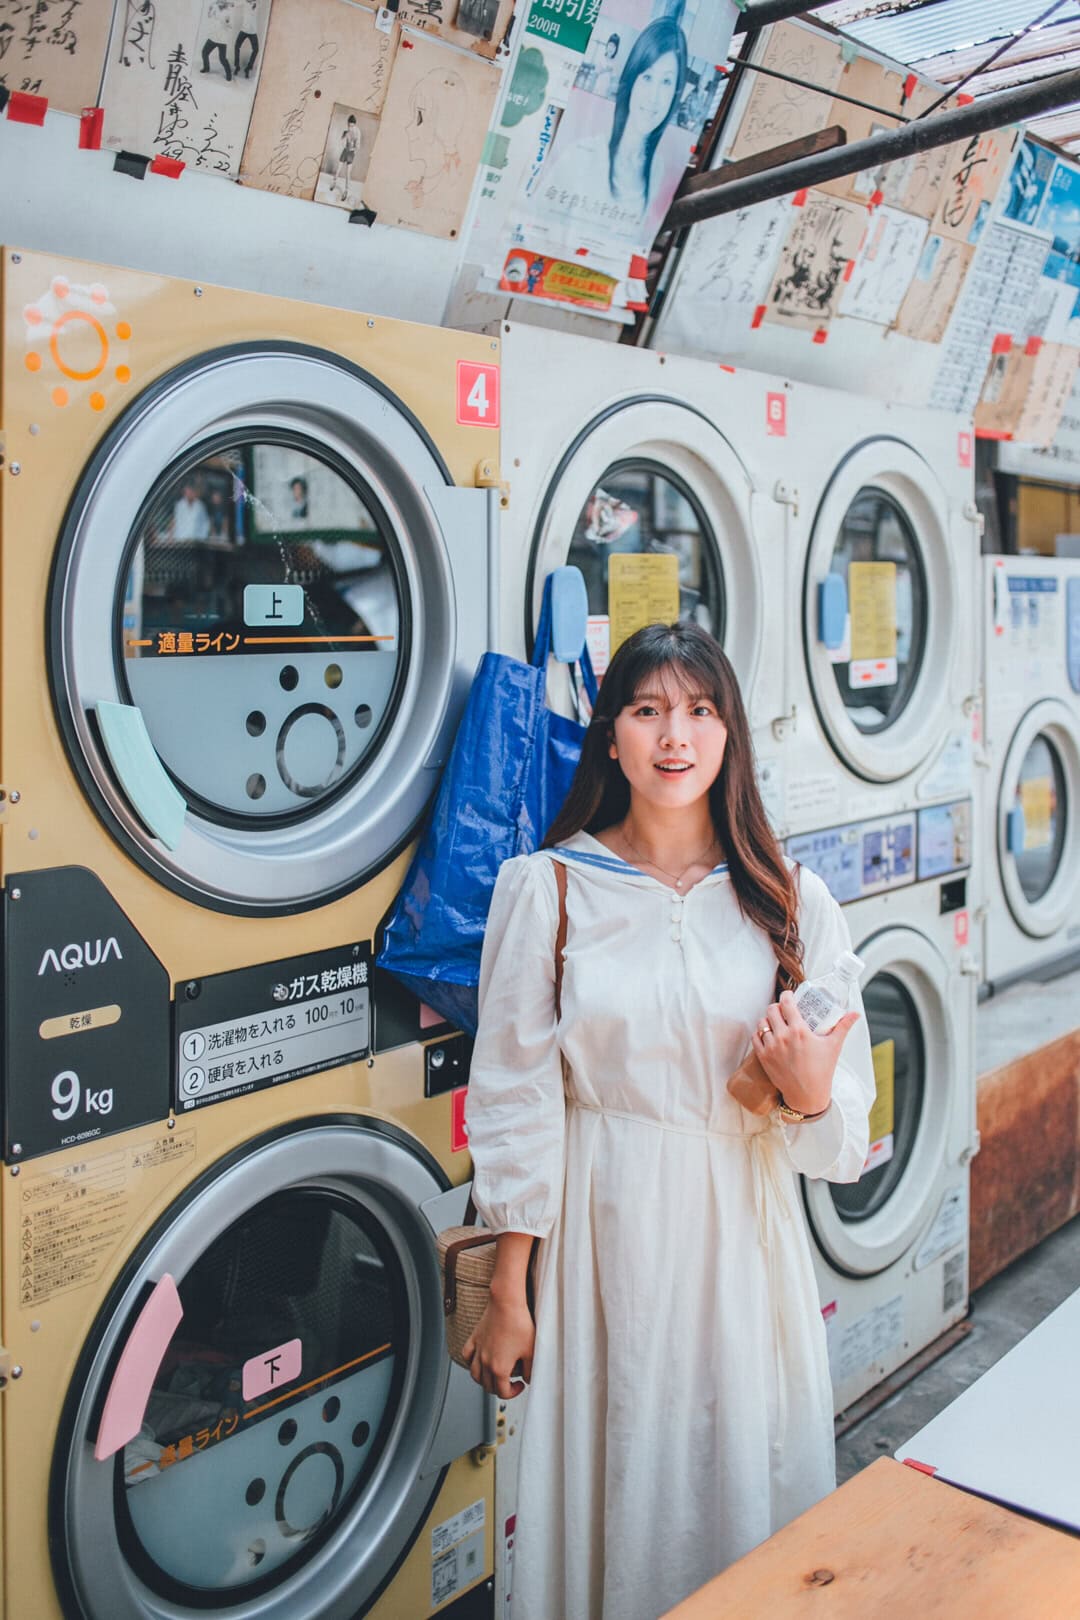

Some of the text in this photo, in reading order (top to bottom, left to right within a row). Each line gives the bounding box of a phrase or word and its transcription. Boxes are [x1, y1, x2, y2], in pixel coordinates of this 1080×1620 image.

[529, 14, 561, 38] 200円
[467, 373, 490, 417] 4
[265, 591, 284, 619] 上
[157, 631, 241, 655] 適量ライン
[37, 937, 123, 976] AQUA
[288, 961, 368, 1000] ガス乾燥機
[69, 1014, 92, 1031] 乾燥
[208, 1014, 297, 1051] 洗濯物を入れる
[207, 1049, 285, 1085] 硬貨を入れる
[263, 1355, 282, 1384] 下
